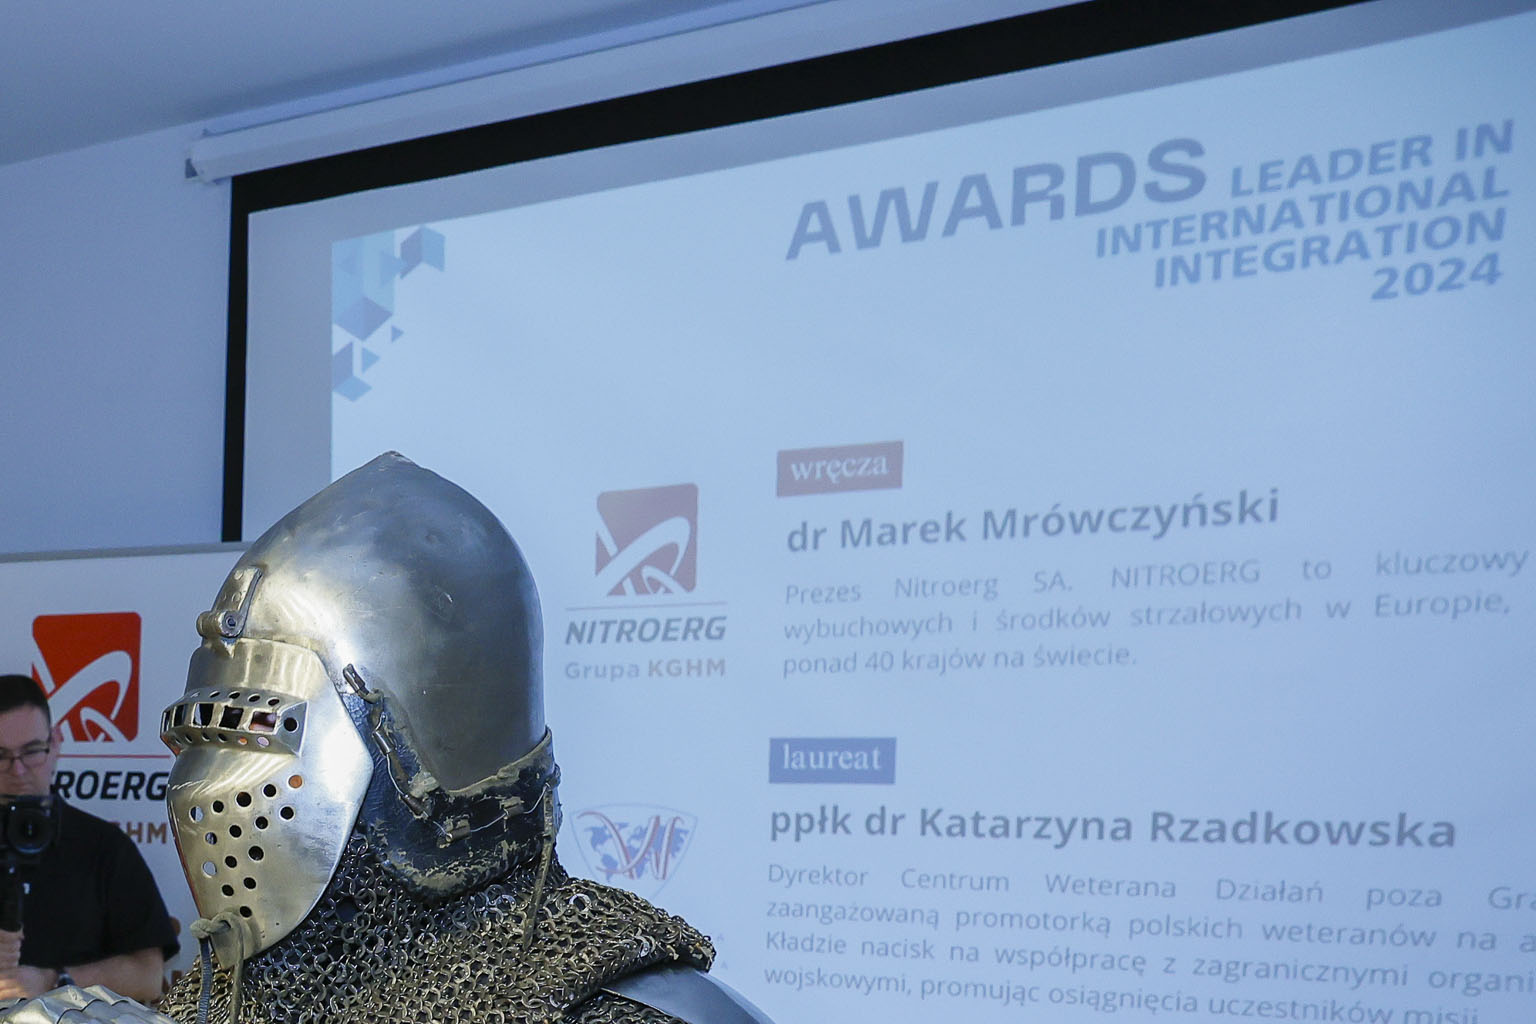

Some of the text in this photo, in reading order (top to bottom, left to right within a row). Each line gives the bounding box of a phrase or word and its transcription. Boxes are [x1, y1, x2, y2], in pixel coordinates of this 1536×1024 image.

[786, 119, 1515, 260] AWARDS LEADER IN
[1096, 165, 1510, 258] INTERNATIONAL
[1155, 207, 1507, 289] INTEGRATION
[1370, 252, 1503, 300] 2024
[791, 454, 888, 483] wręcza
[788, 488, 1279, 551] dr Marek Mrówczyński
[786, 551, 1529, 604] Prezes Nitroerg SA. NITROERG to kluczowy
[565, 616, 727, 645] NITROERG
[784, 611, 952, 644] wybuchowych
[972, 611, 977, 630] i
[996, 606, 1111, 631] środków
[1130, 597, 1302, 628] strzałowych
[1326, 601, 1351, 618] w
[565, 658, 726, 681] Grupa KGHM
[784, 643, 1136, 678] ponad 40 krajów na świecie.
[783, 743, 882, 771] laureat
[54, 770, 169, 801] ROERG
[771, 805, 1455, 849] ppłk dr Katarzyna Rzadkowska
[768, 864, 868, 888] Dyrektor
[901, 869, 1010, 892] Centrum
[1045, 874, 1177, 899] Weterana
[1217, 879, 1324, 902] Działań
[1366, 888, 1442, 910] poza
[766, 899, 939, 930] zaangażowaną
[955, 910, 1111, 938] promotorką
[1128, 913, 1244, 940] polskich
[1263, 924, 1436, 948] weteranów
[1457, 931, 1496, 951] na
[766, 930, 847, 954] Kładzie
[861, 939, 935, 959] nacisk
[950, 945, 979, 962] na
[995, 947, 1146, 975] współpracę
[1164, 957, 1175, 974] z
[1192, 957, 1407, 990] zagranicznymi
[764, 968, 911, 996] wojskowymi,
[921, 978, 1039, 1006] promując
[1048, 985, 1198, 1015] osiągnięcia
